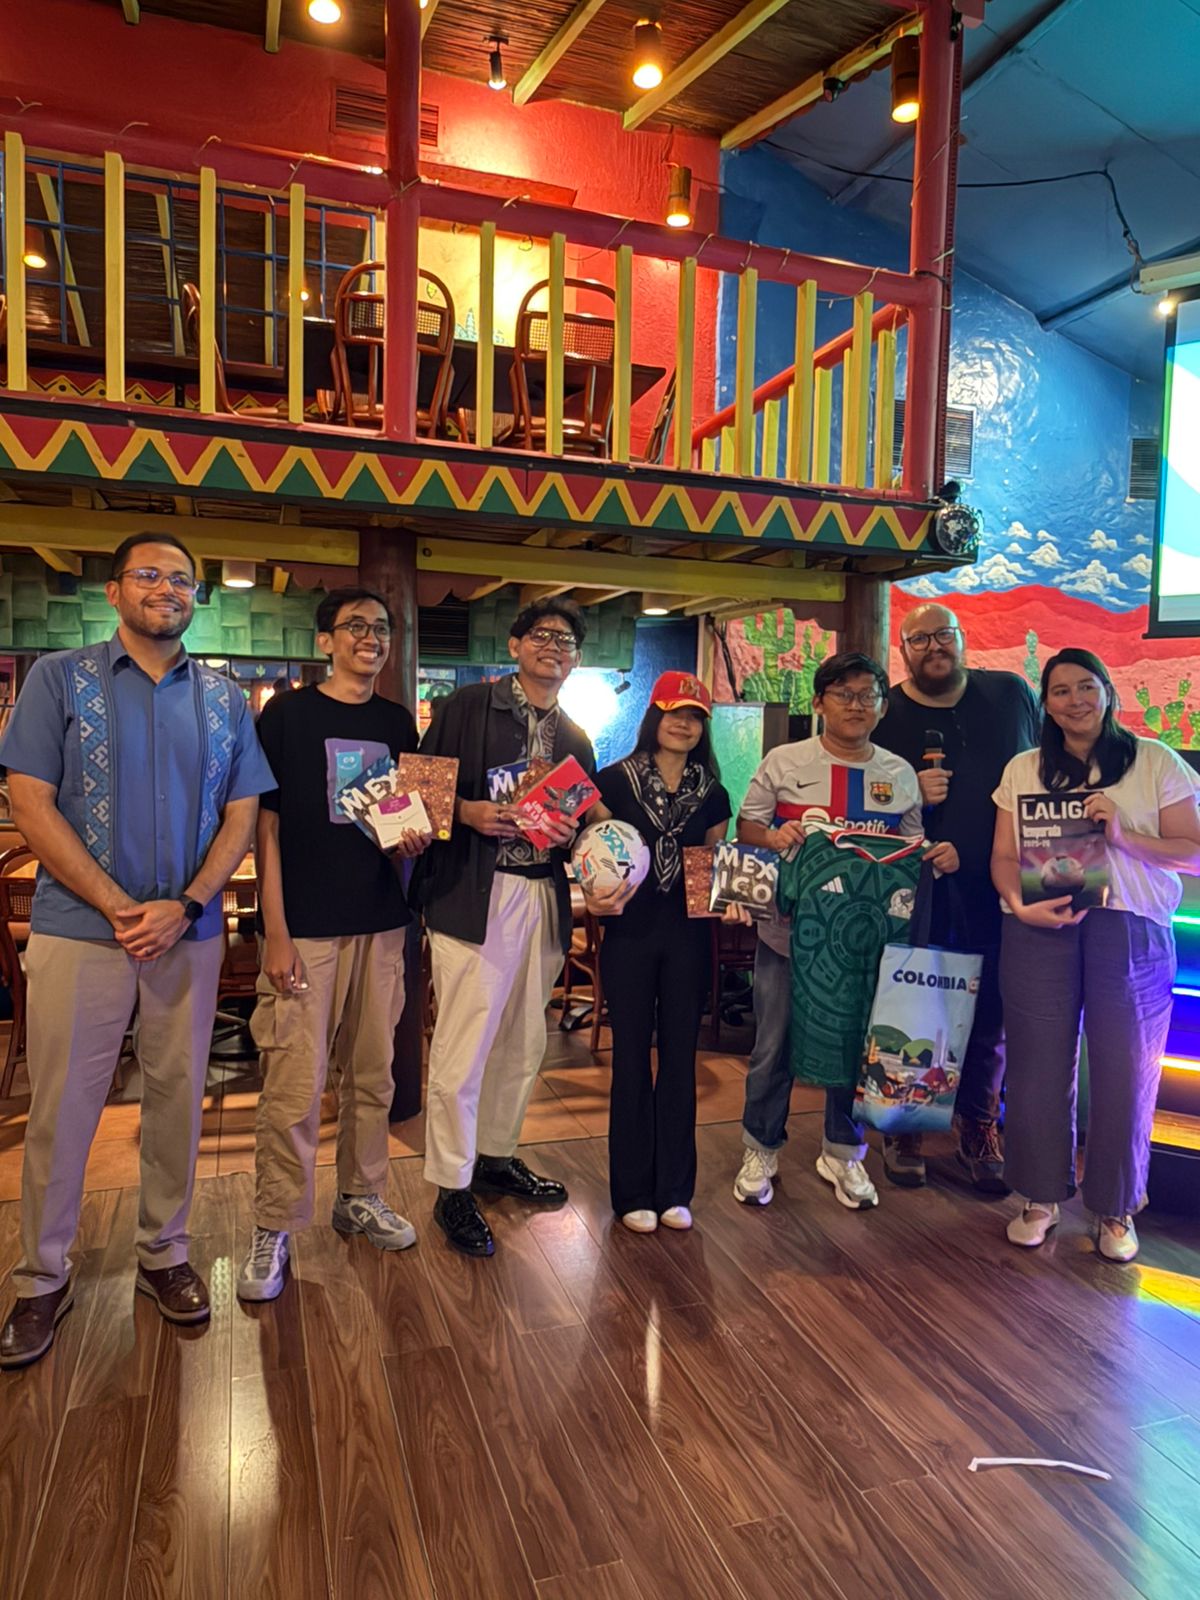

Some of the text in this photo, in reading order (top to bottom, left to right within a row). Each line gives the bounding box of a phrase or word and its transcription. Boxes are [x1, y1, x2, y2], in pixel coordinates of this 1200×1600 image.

[718, 845, 775, 881] MEX
[720, 871, 772, 904] ICO
[892, 969, 967, 991] COLOMBIA
